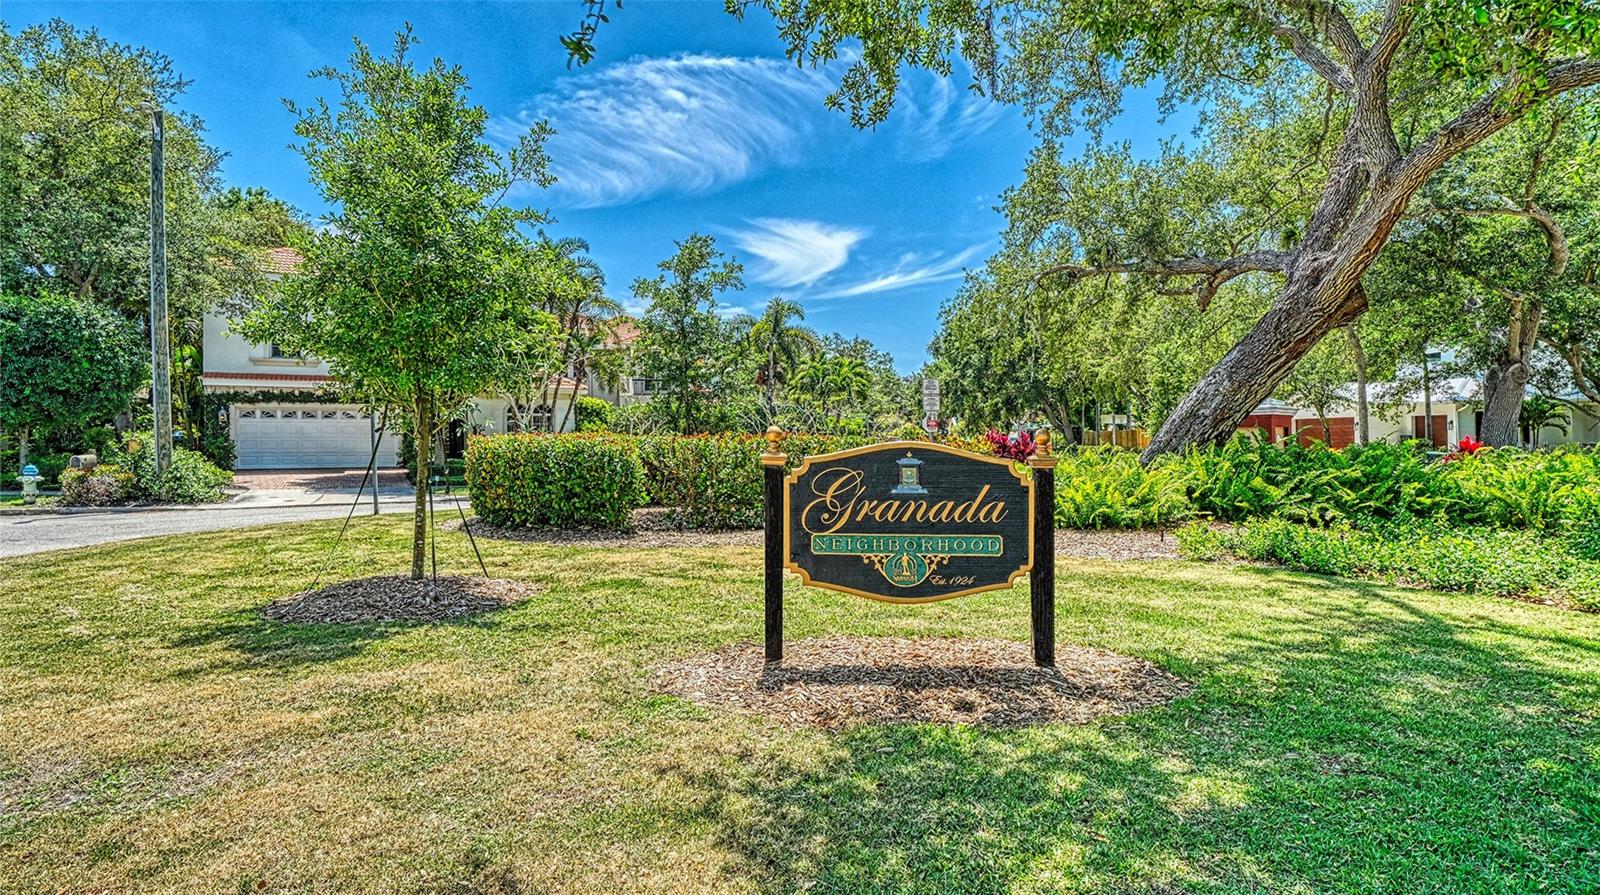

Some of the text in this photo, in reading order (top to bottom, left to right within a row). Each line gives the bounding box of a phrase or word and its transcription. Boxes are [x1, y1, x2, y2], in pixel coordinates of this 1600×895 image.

[801, 467, 1008, 535] Granada
[815, 538, 1000, 551] NEIGHBORHOOD
[949, 576, 976, 586] 1924
